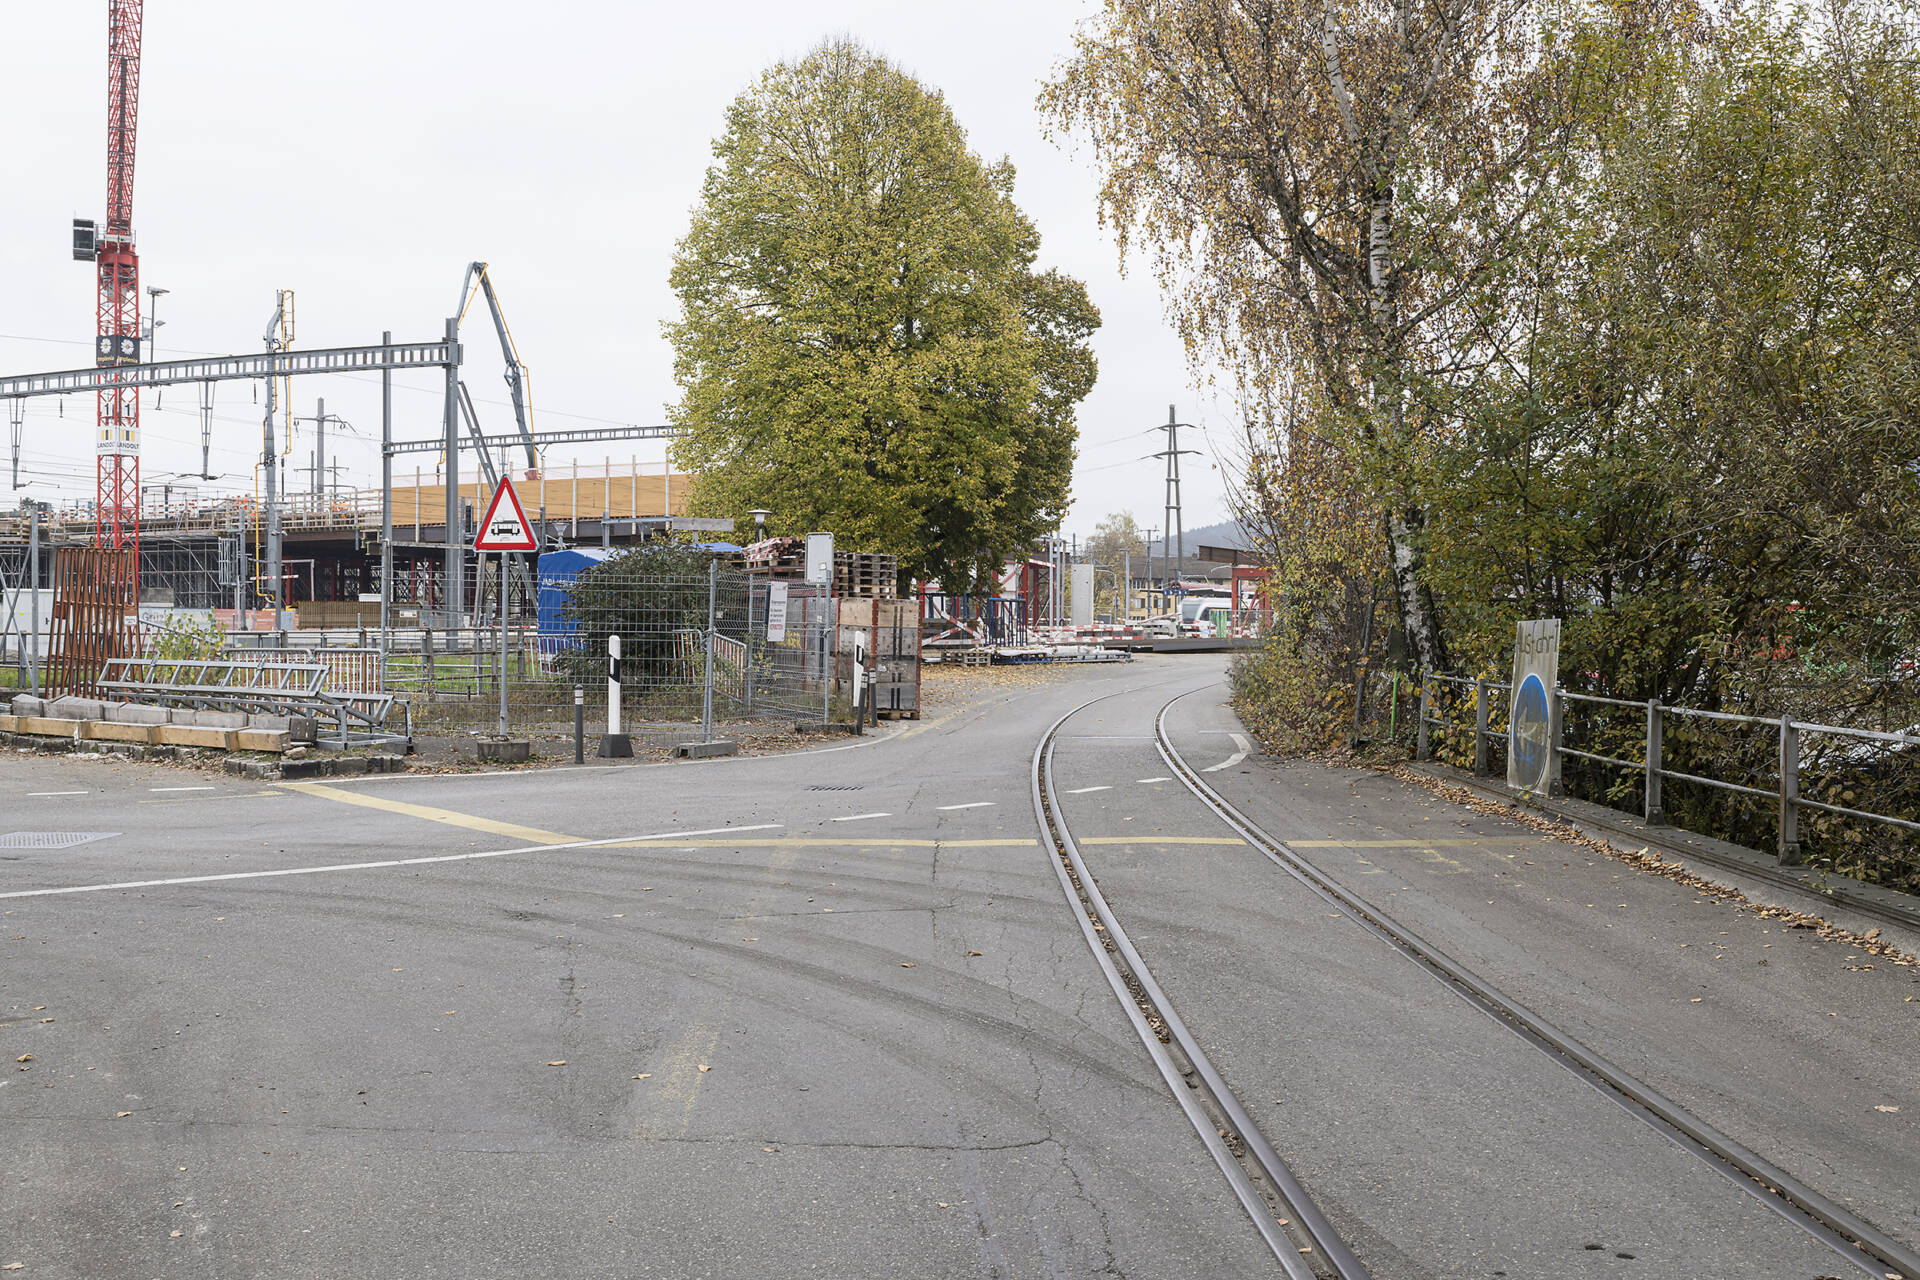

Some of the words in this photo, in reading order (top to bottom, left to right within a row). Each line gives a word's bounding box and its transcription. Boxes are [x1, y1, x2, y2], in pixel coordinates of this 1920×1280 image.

[104, 403, 109, 416] 1
[124, 403, 130, 416] 1
[117, 442, 139, 450] LANDOLT
